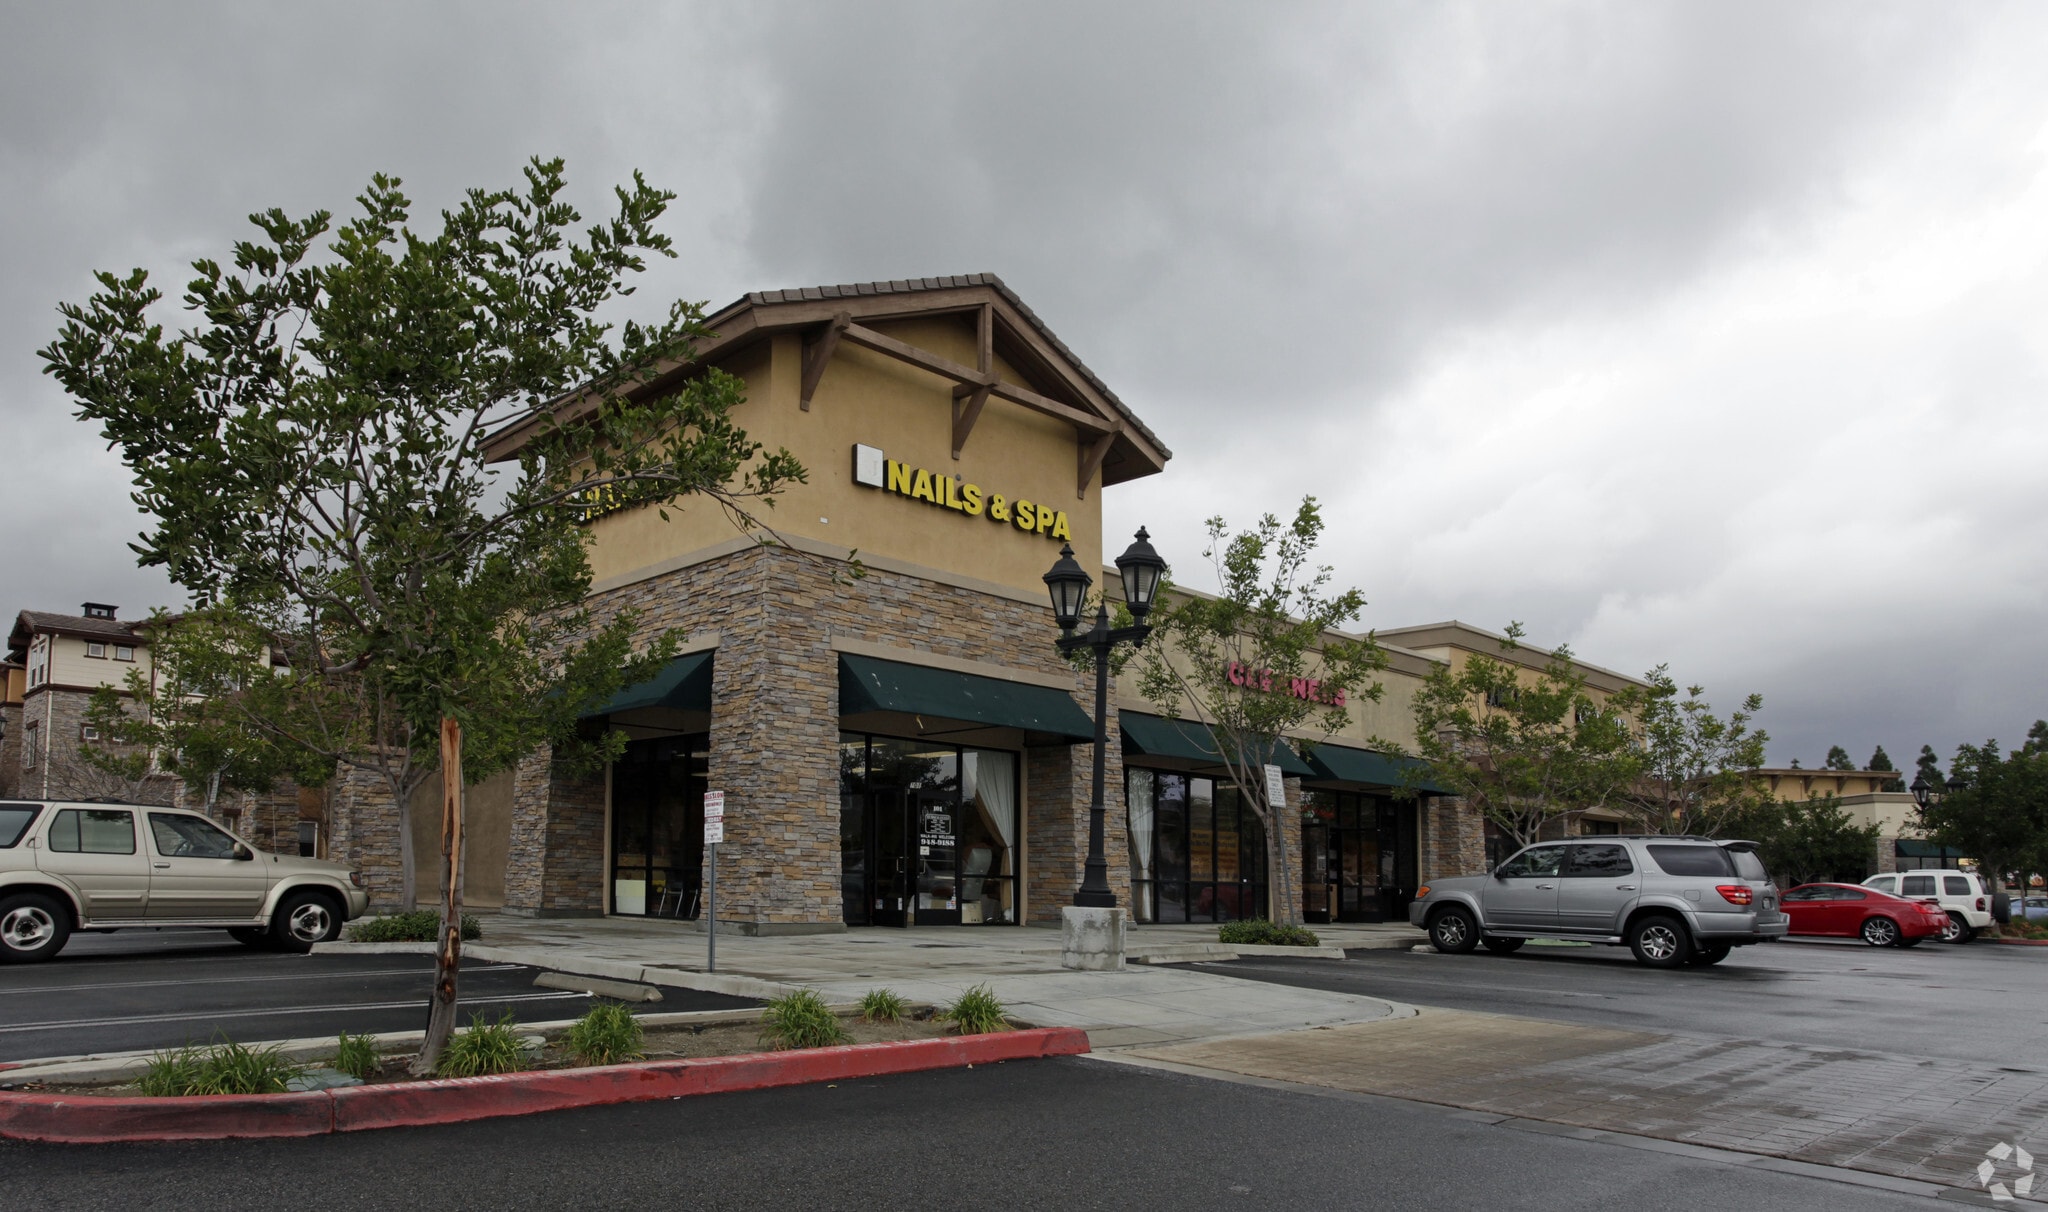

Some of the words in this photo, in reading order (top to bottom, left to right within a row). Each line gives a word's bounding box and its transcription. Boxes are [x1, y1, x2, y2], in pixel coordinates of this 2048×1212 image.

[886, 459, 983, 516] NAILS
[989, 493, 1010, 522] &
[1015, 499, 1071, 541] SPA
